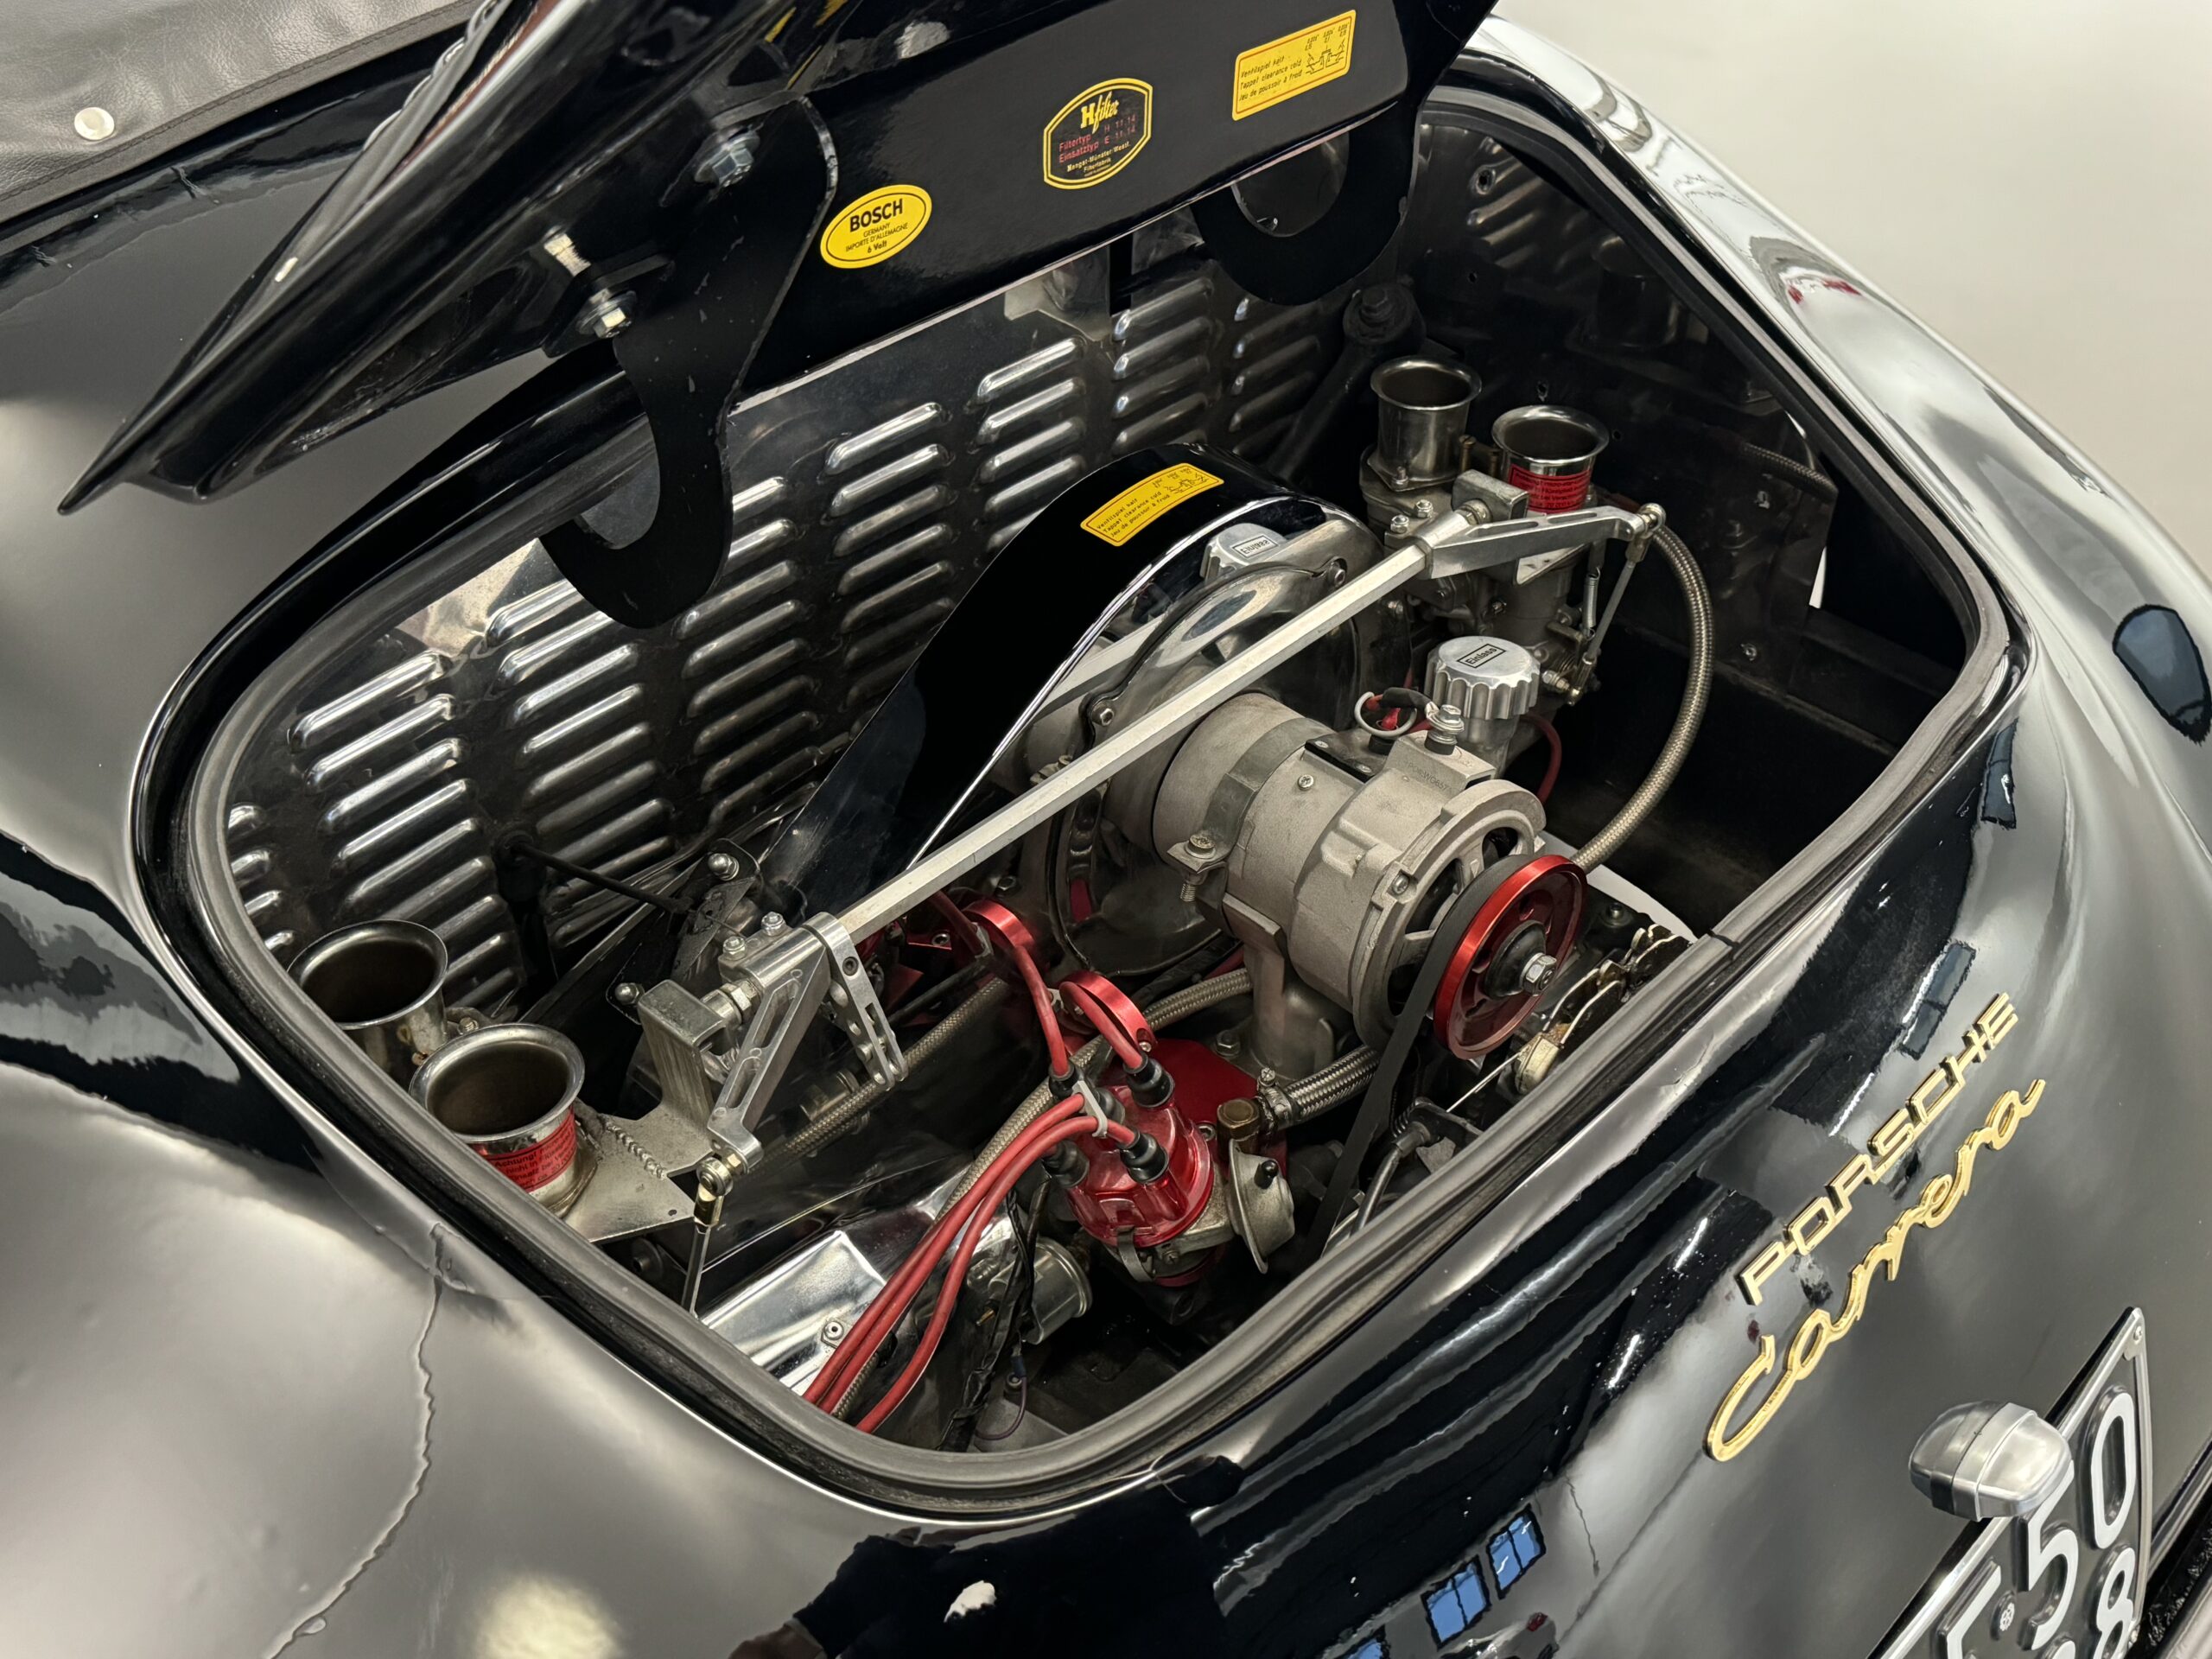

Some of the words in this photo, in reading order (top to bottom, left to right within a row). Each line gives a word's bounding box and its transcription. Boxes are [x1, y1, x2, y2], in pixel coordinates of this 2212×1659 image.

[1240, 76, 1259, 90] Tappet
[1262, 67, 1288, 81] clearance
[1290, 59, 1302, 69] cold
[1059, 134, 1091, 152] Filtertyp
[1059, 141, 1099, 163] Einsatztyp
[850, 198, 903, 232] BOSCH
[846, 238, 869, 252] IMPORTE
[870, 222, 908, 243] D'ALLEMAGNE
[863, 222, 891, 238] GERMANY
[874, 240, 887, 251] Volt
[1103, 518, 1122, 533] Tappet
[1124, 499, 1149, 518] clearance
[1465, 647, 1497, 664] Einlass
[494, 1151, 537, 1167] Achtung!
[1735, 992, 2019, 1306] PORSCHE
[1702, 1078, 2046, 1462] Carrera
